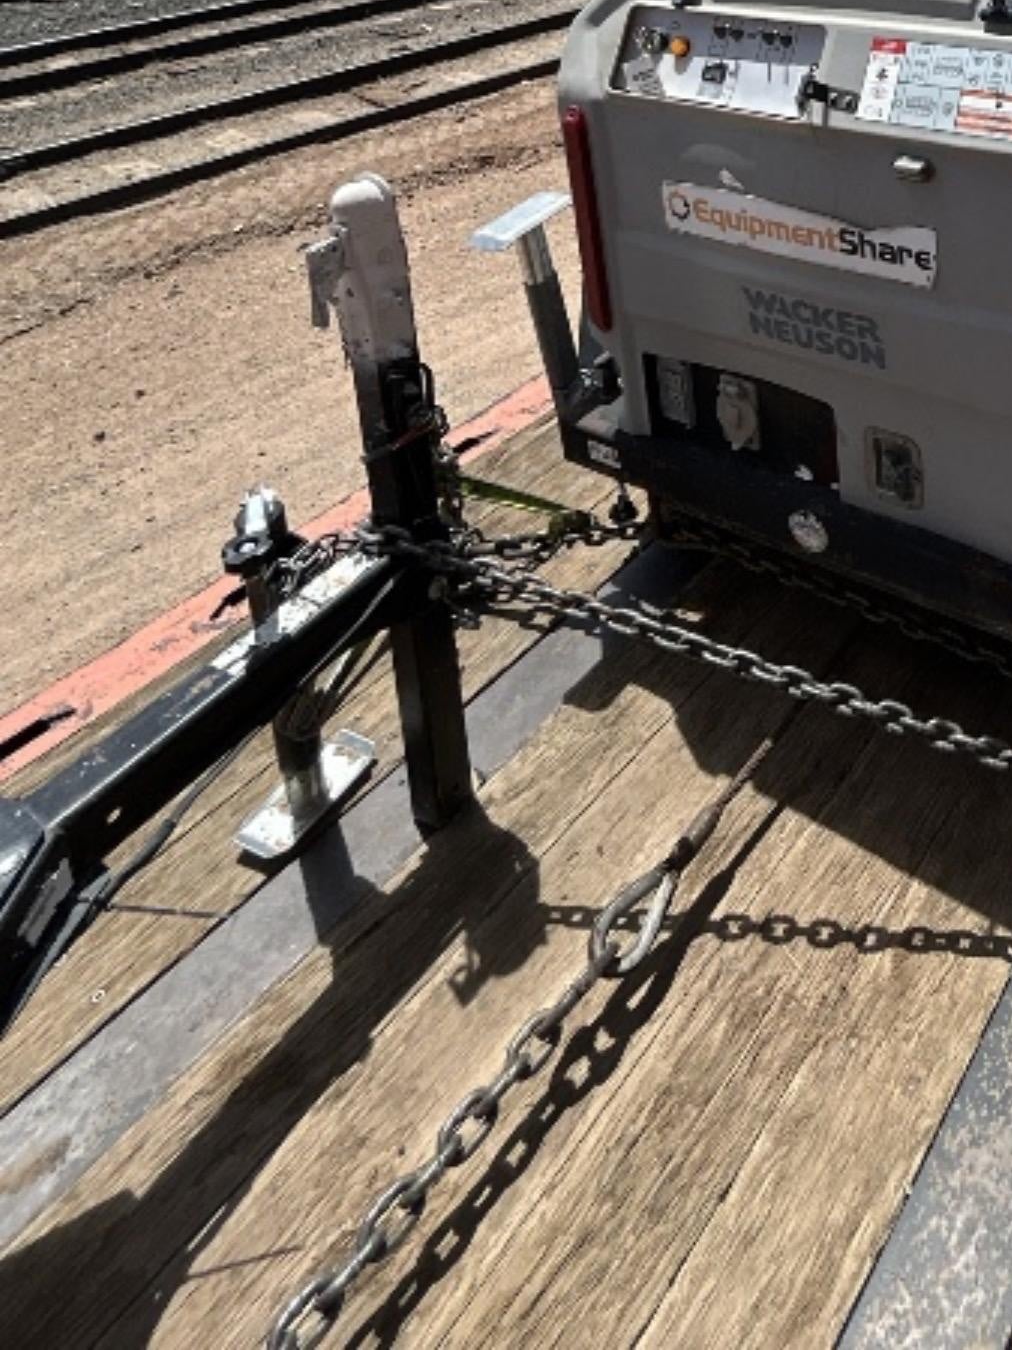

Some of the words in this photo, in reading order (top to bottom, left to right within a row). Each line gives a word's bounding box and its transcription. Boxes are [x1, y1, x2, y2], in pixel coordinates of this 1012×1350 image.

[692, 197, 934, 270] EquipmentShare
[741, 285, 886, 343] WACKER
[750, 310, 887, 370] NEUSON
